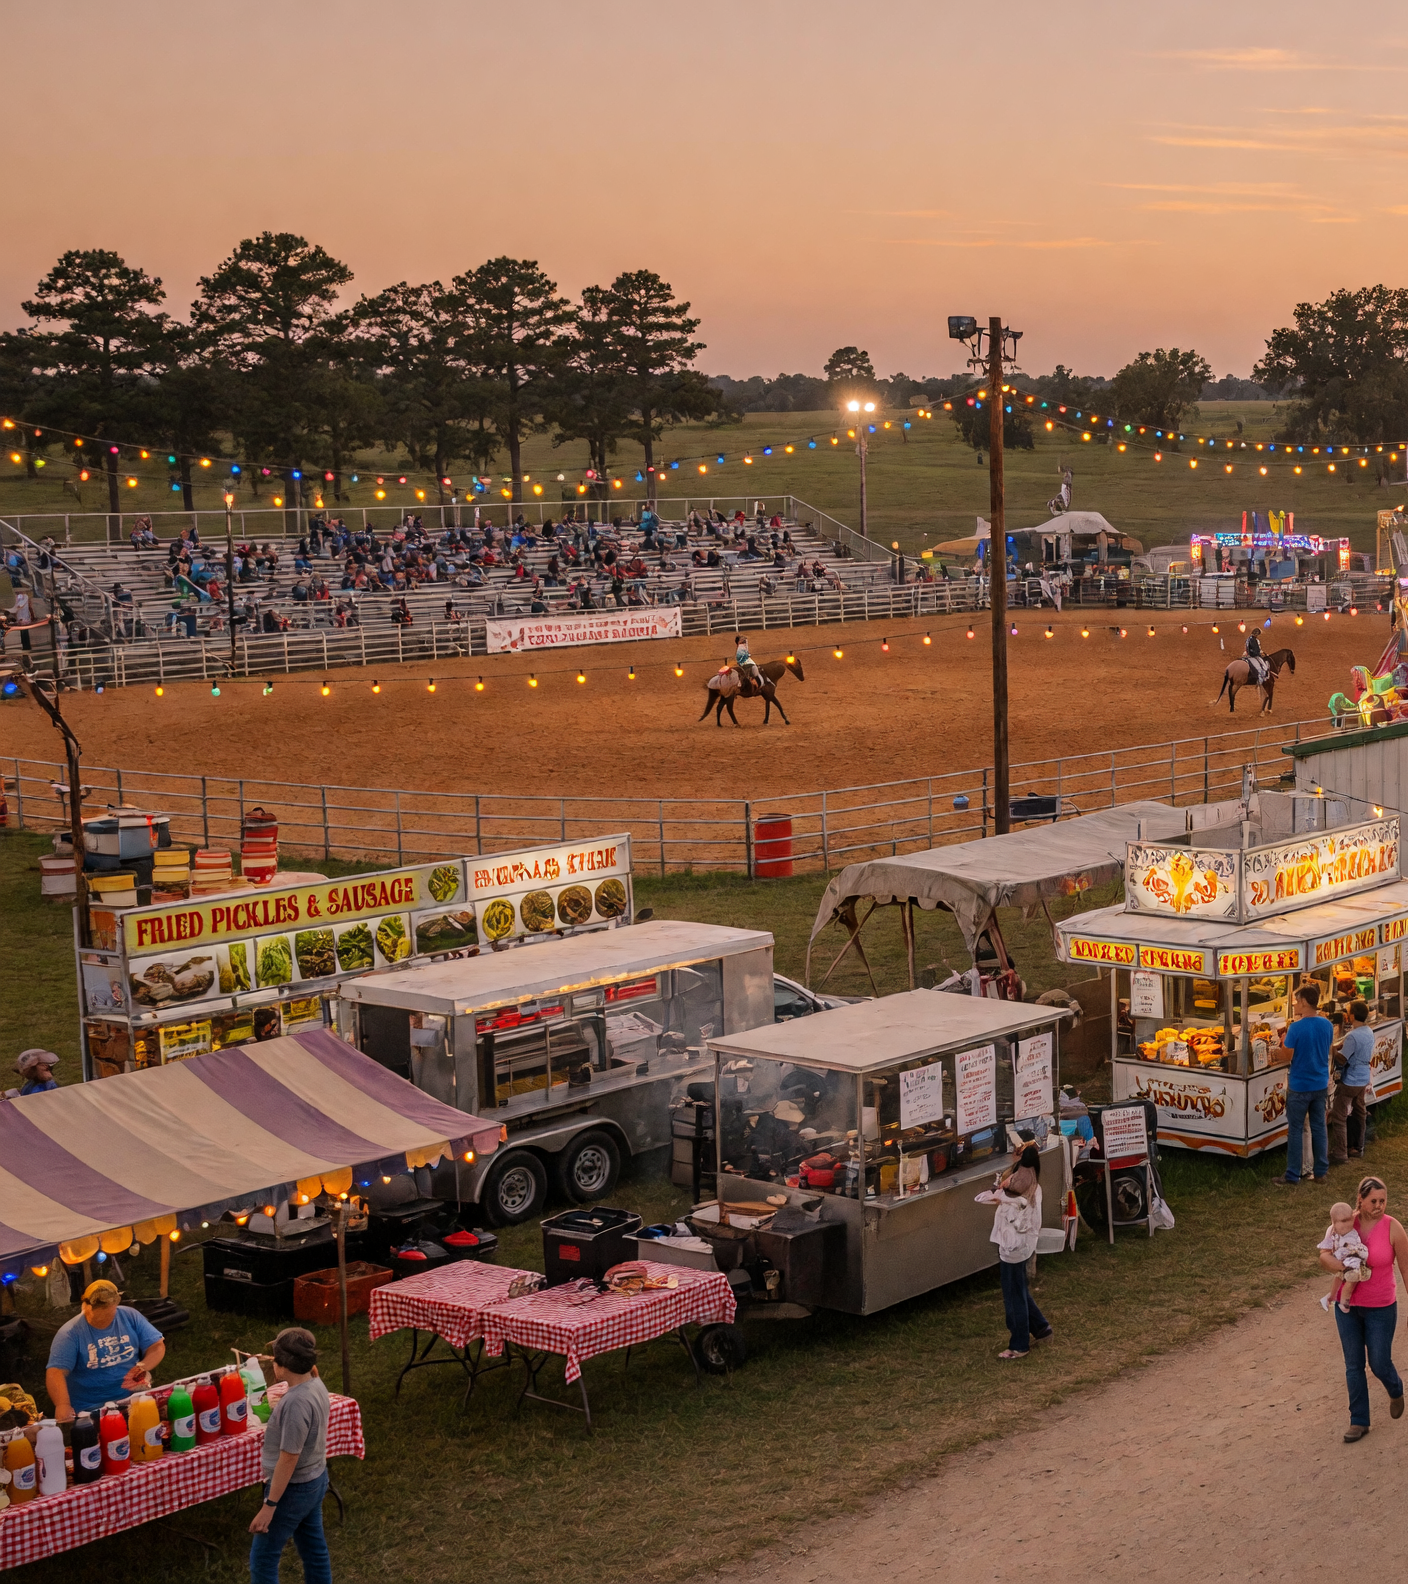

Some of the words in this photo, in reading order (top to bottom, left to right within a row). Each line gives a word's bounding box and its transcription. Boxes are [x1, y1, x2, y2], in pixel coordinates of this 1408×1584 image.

[136, 911, 203, 946] FRIED
[211, 895, 300, 933] PICKLES
[307, 894, 322, 918] &
[327, 877, 414, 915] SAUSAGE
